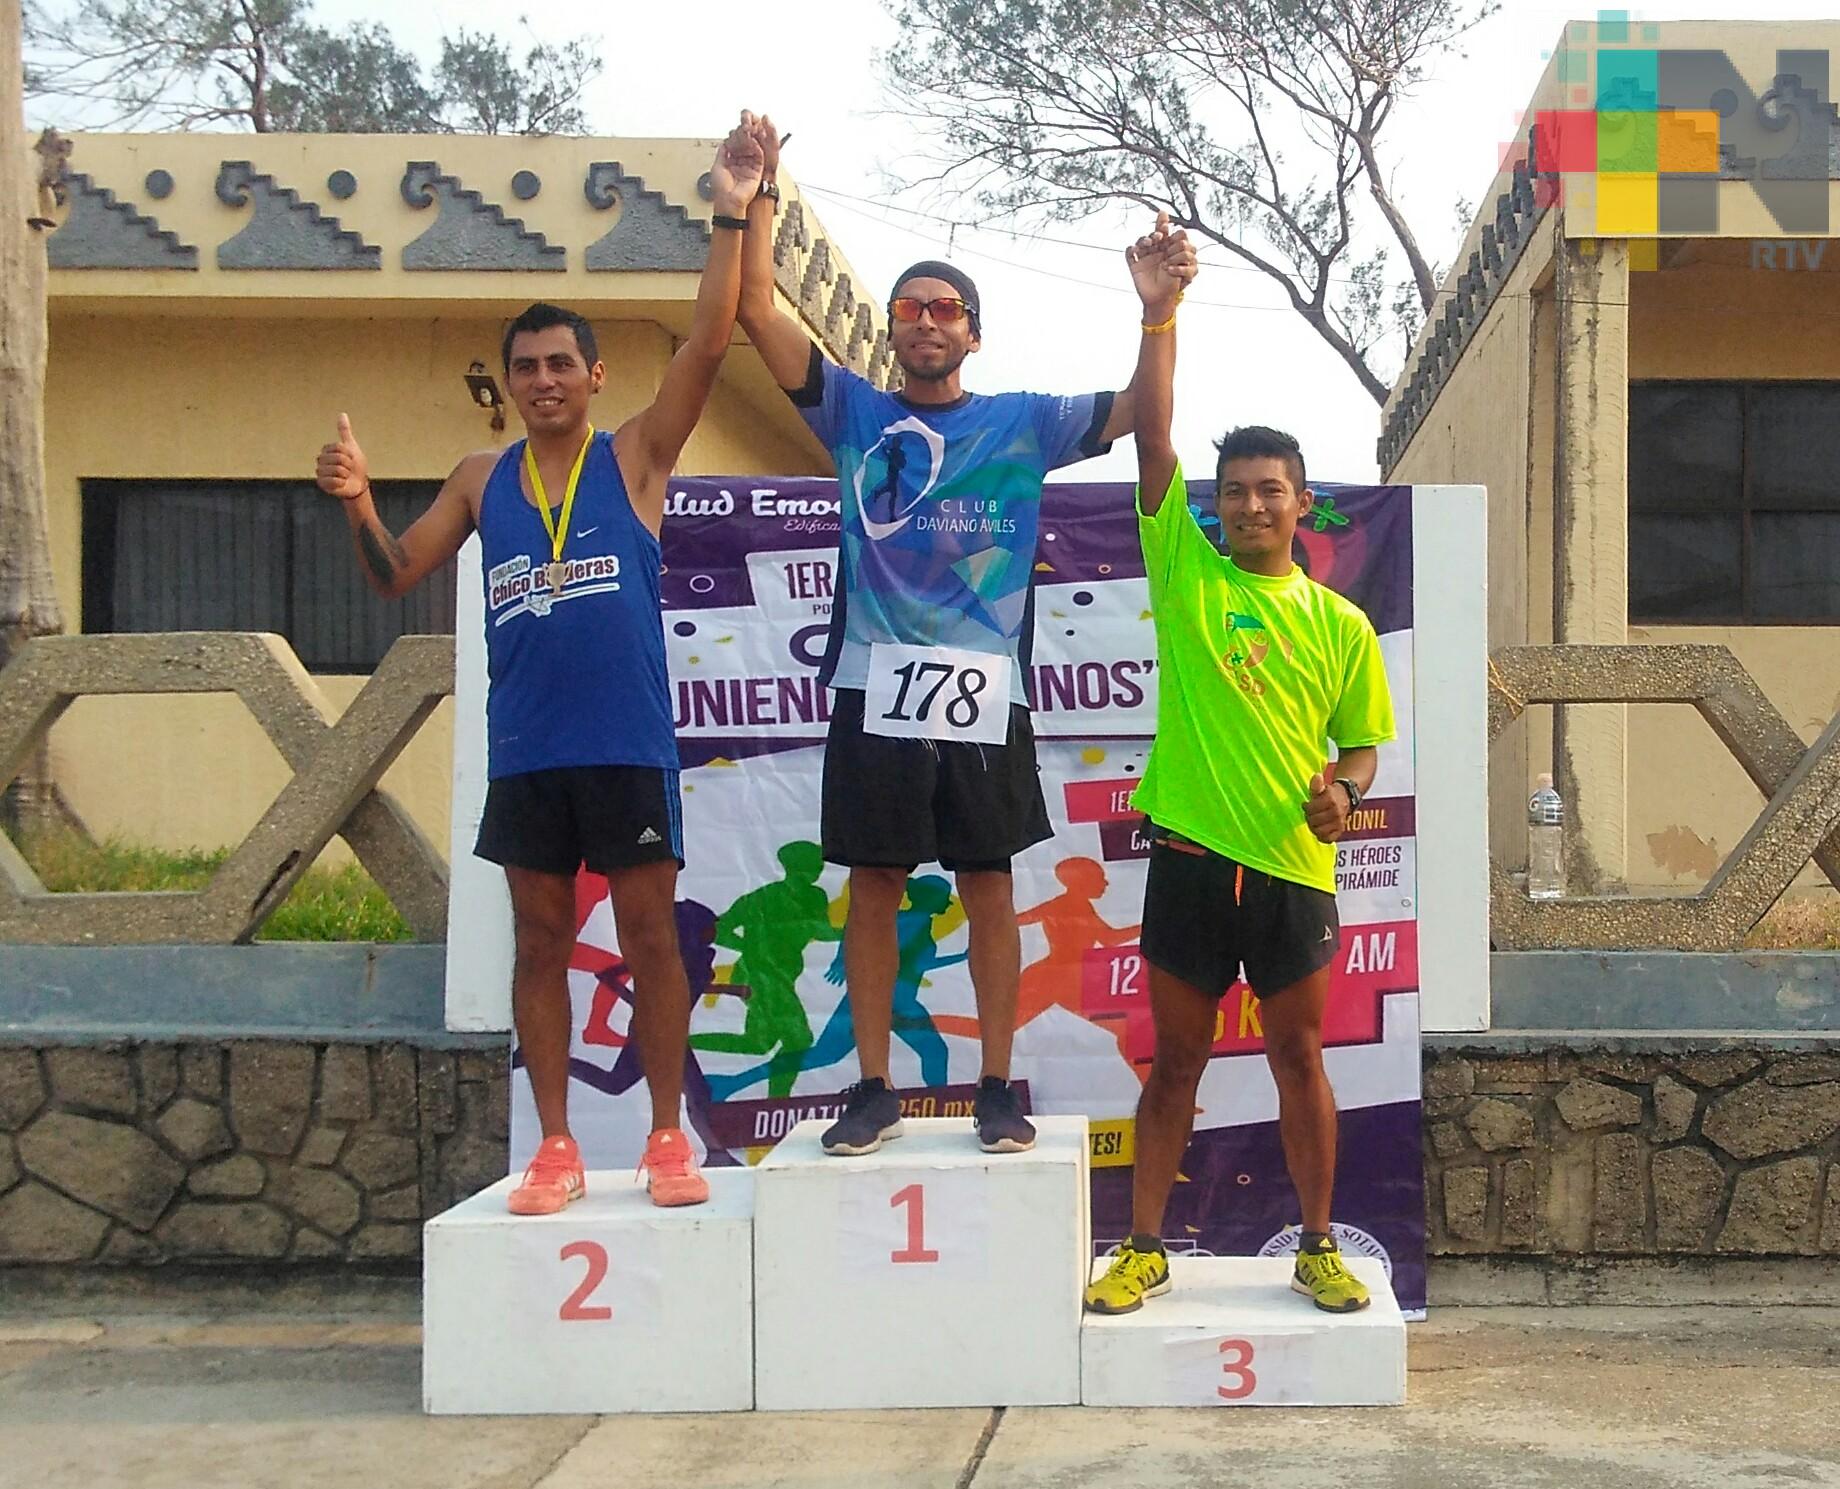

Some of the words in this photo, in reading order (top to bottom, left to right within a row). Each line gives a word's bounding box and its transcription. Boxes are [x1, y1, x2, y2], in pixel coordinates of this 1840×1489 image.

[916, 516, 977, 532] DAVIANO
[979, 518, 1016, 533] AVILES
[940, 499, 997, 513] CLUB
[881, 660, 987, 728] 178
[1335, 868, 1400, 891] PIRÁMIDE
[1350, 844, 1402, 867] HÉROES
[1110, 955, 1141, 995] 12
[1345, 931, 1396, 974] AM
[890, 1184, 940, 1263] 1
[559, 1241, 613, 1321] 2
[1217, 1339, 1257, 1399] 3
